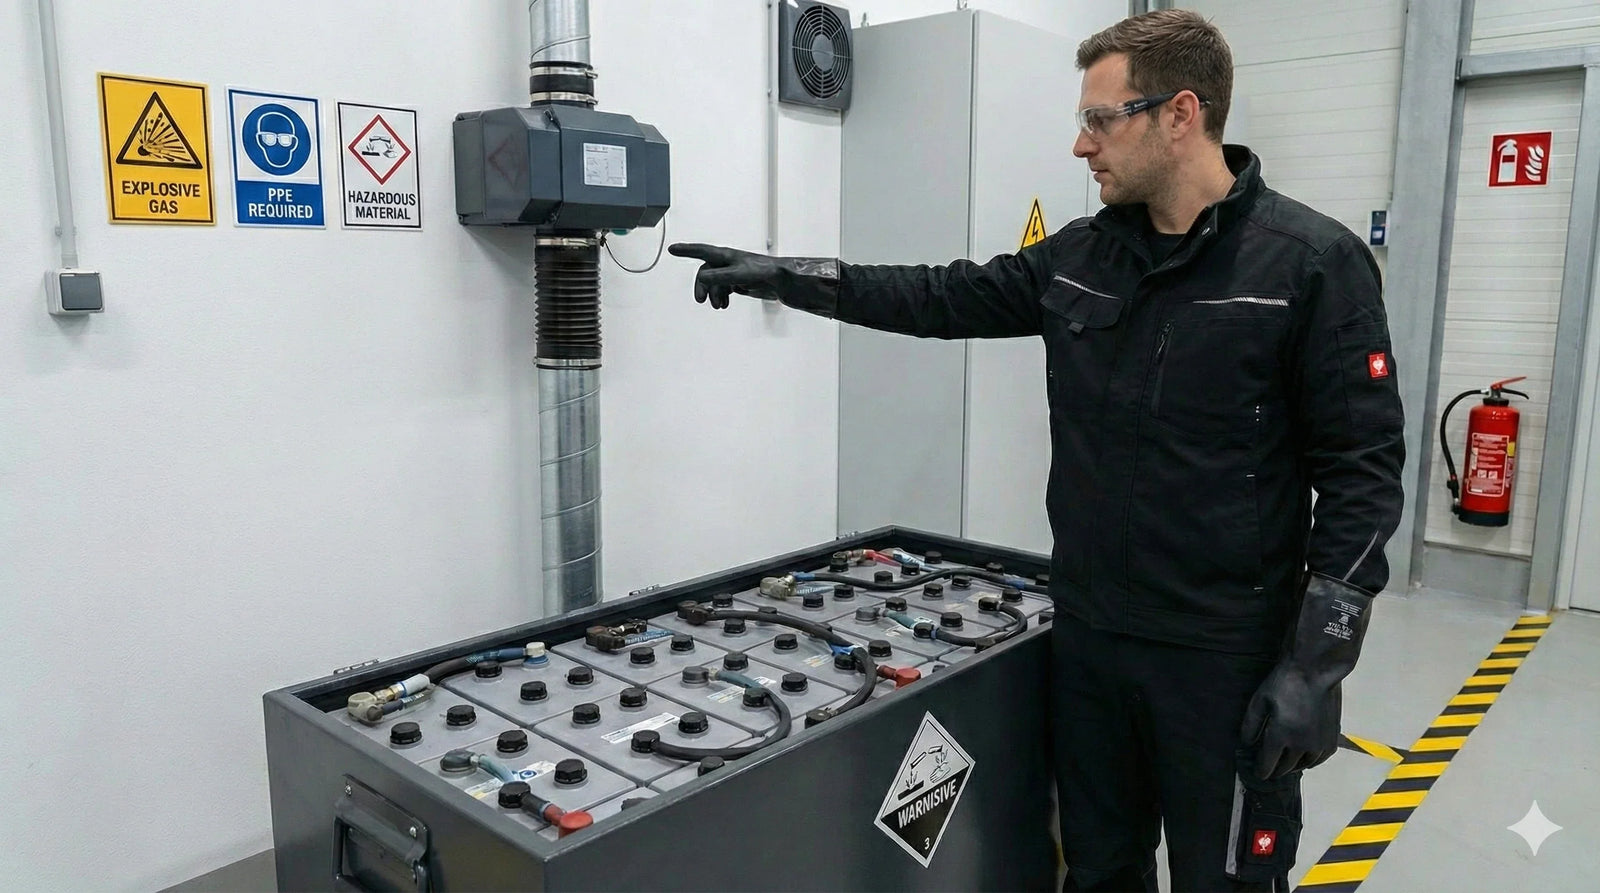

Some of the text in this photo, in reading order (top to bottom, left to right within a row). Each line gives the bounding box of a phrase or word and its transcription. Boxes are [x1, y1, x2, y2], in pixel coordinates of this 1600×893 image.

[122, 181, 201, 198] EXPLOSIVE
[268, 188, 293, 203] PPE
[348, 190, 416, 207] HAZARDOUS
[148, 199, 179, 215] GAS
[248, 202, 314, 219] REQUIRED
[355, 206, 411, 221] MATERIAL
[898, 778, 957, 829] WARNISIVE
[924, 837, 930, 849] 3
